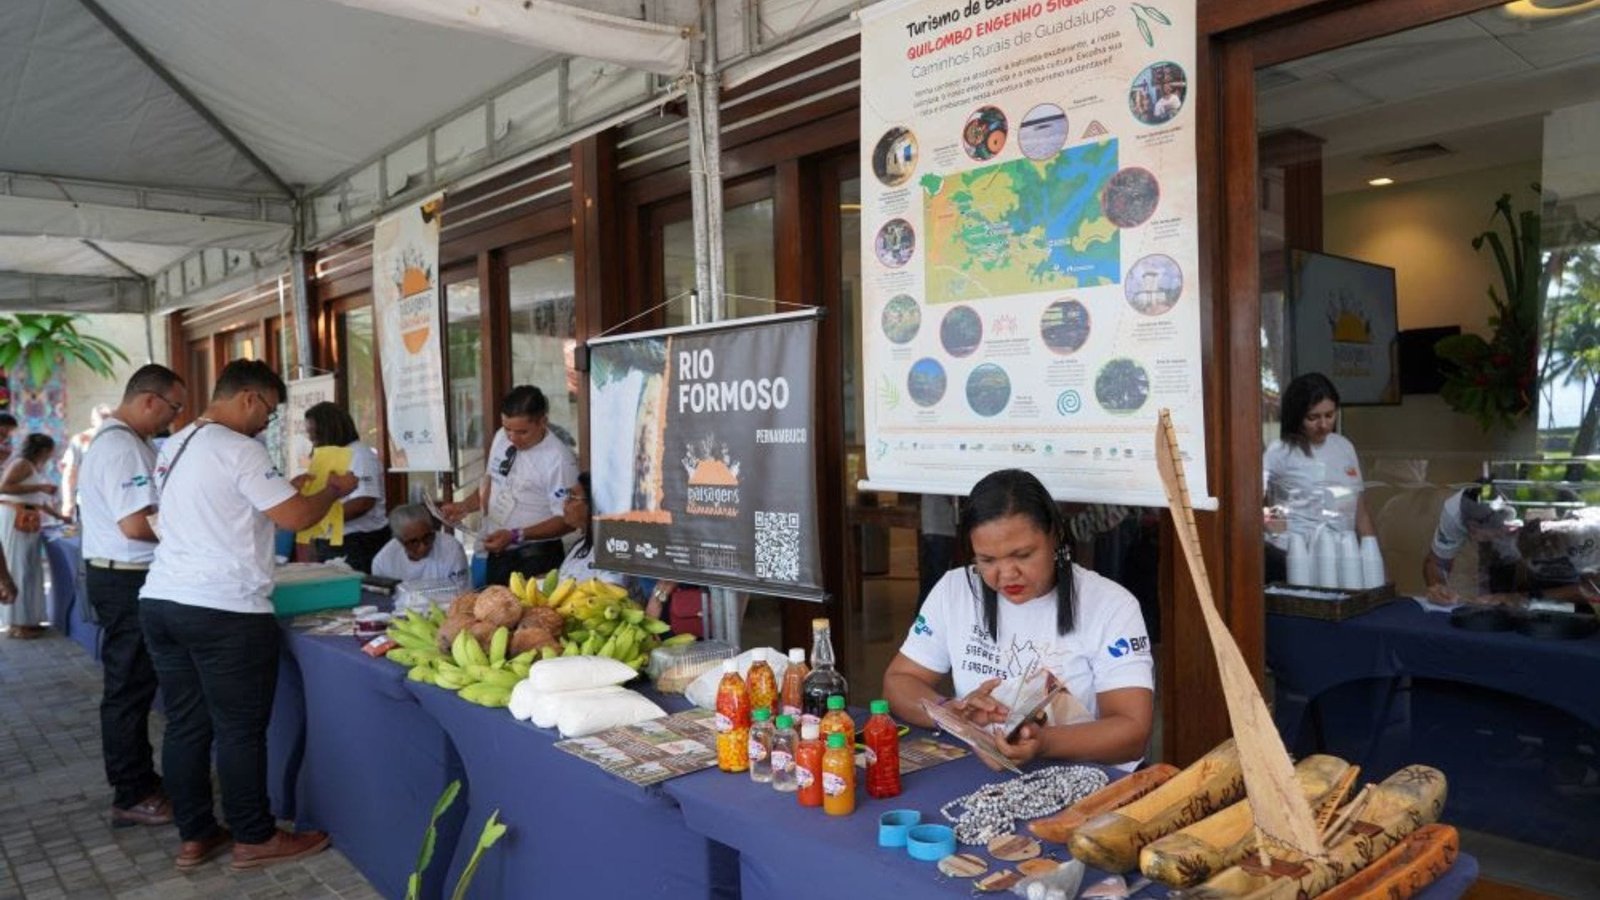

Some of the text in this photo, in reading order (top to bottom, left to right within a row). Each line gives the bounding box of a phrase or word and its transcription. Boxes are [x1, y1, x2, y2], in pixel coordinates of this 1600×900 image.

[907, 9, 960, 38] Turismo
[964, 0, 981, 18] de
[907, 27, 972, 60] QUILOMBO
[976, 3, 1042, 37] ENGENHO
[911, 5, 1116, 79] Caminhos Rurais de Guadalupe
[679, 349, 714, 380] RIO
[679, 376, 790, 413] FORMOSO
[756, 428, 807, 444] PERNAMBUCO
